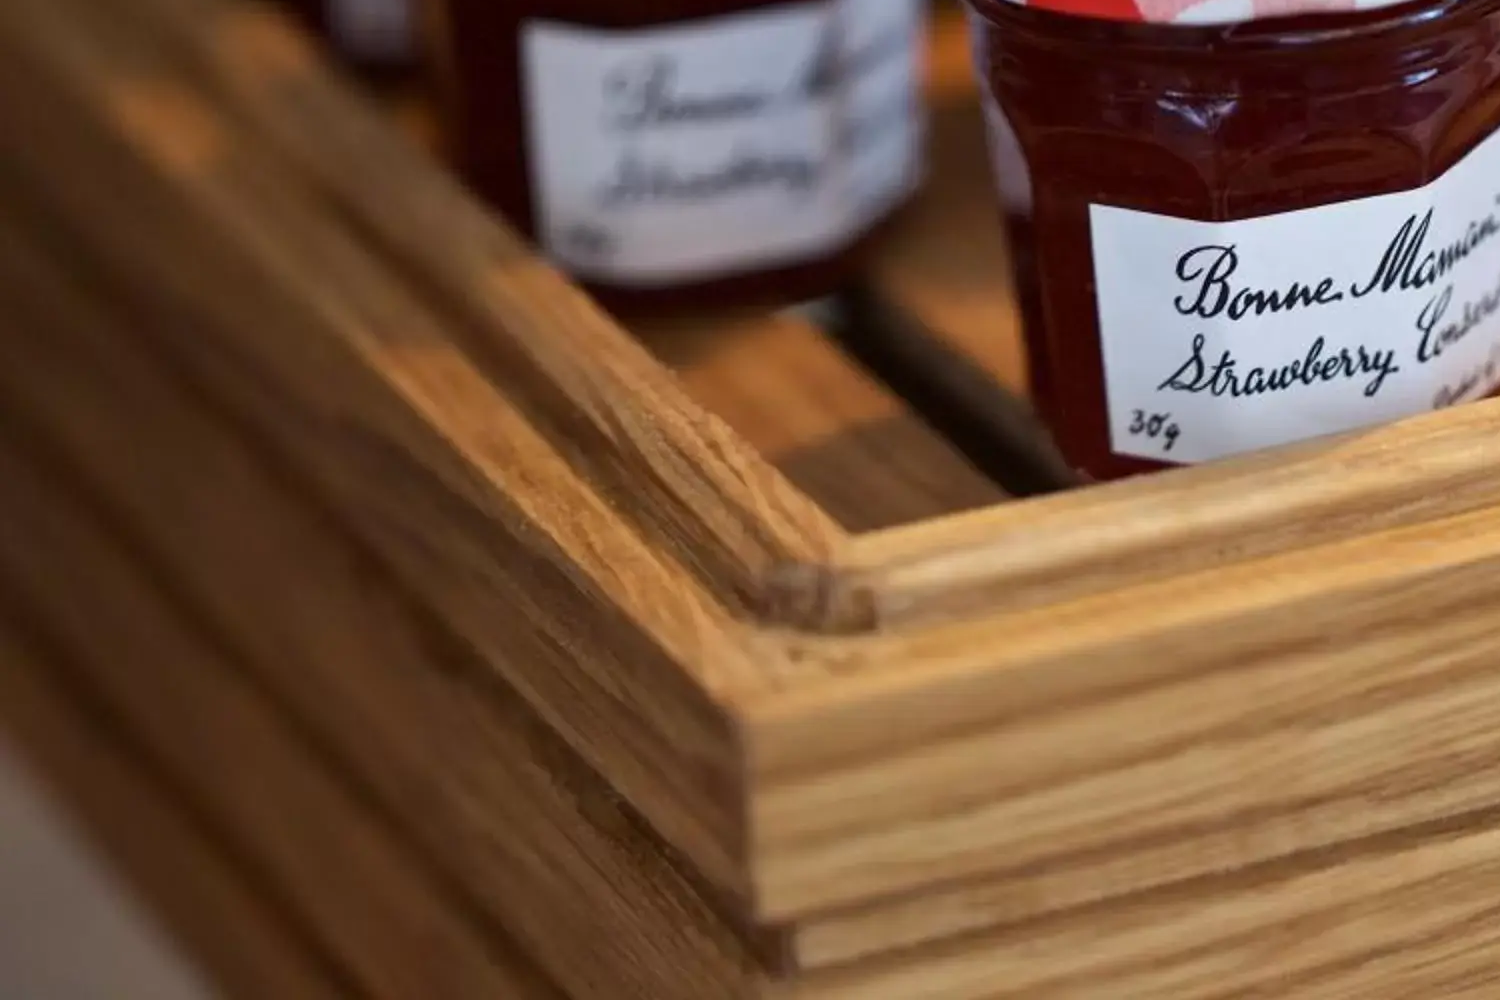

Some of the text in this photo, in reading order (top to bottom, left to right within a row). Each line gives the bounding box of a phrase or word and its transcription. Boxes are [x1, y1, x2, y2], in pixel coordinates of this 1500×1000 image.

[1174, 244, 1344, 321] Bonne
[1157, 333, 1400, 398] Strawberry
[1127, 408, 1181, 452] 30g
